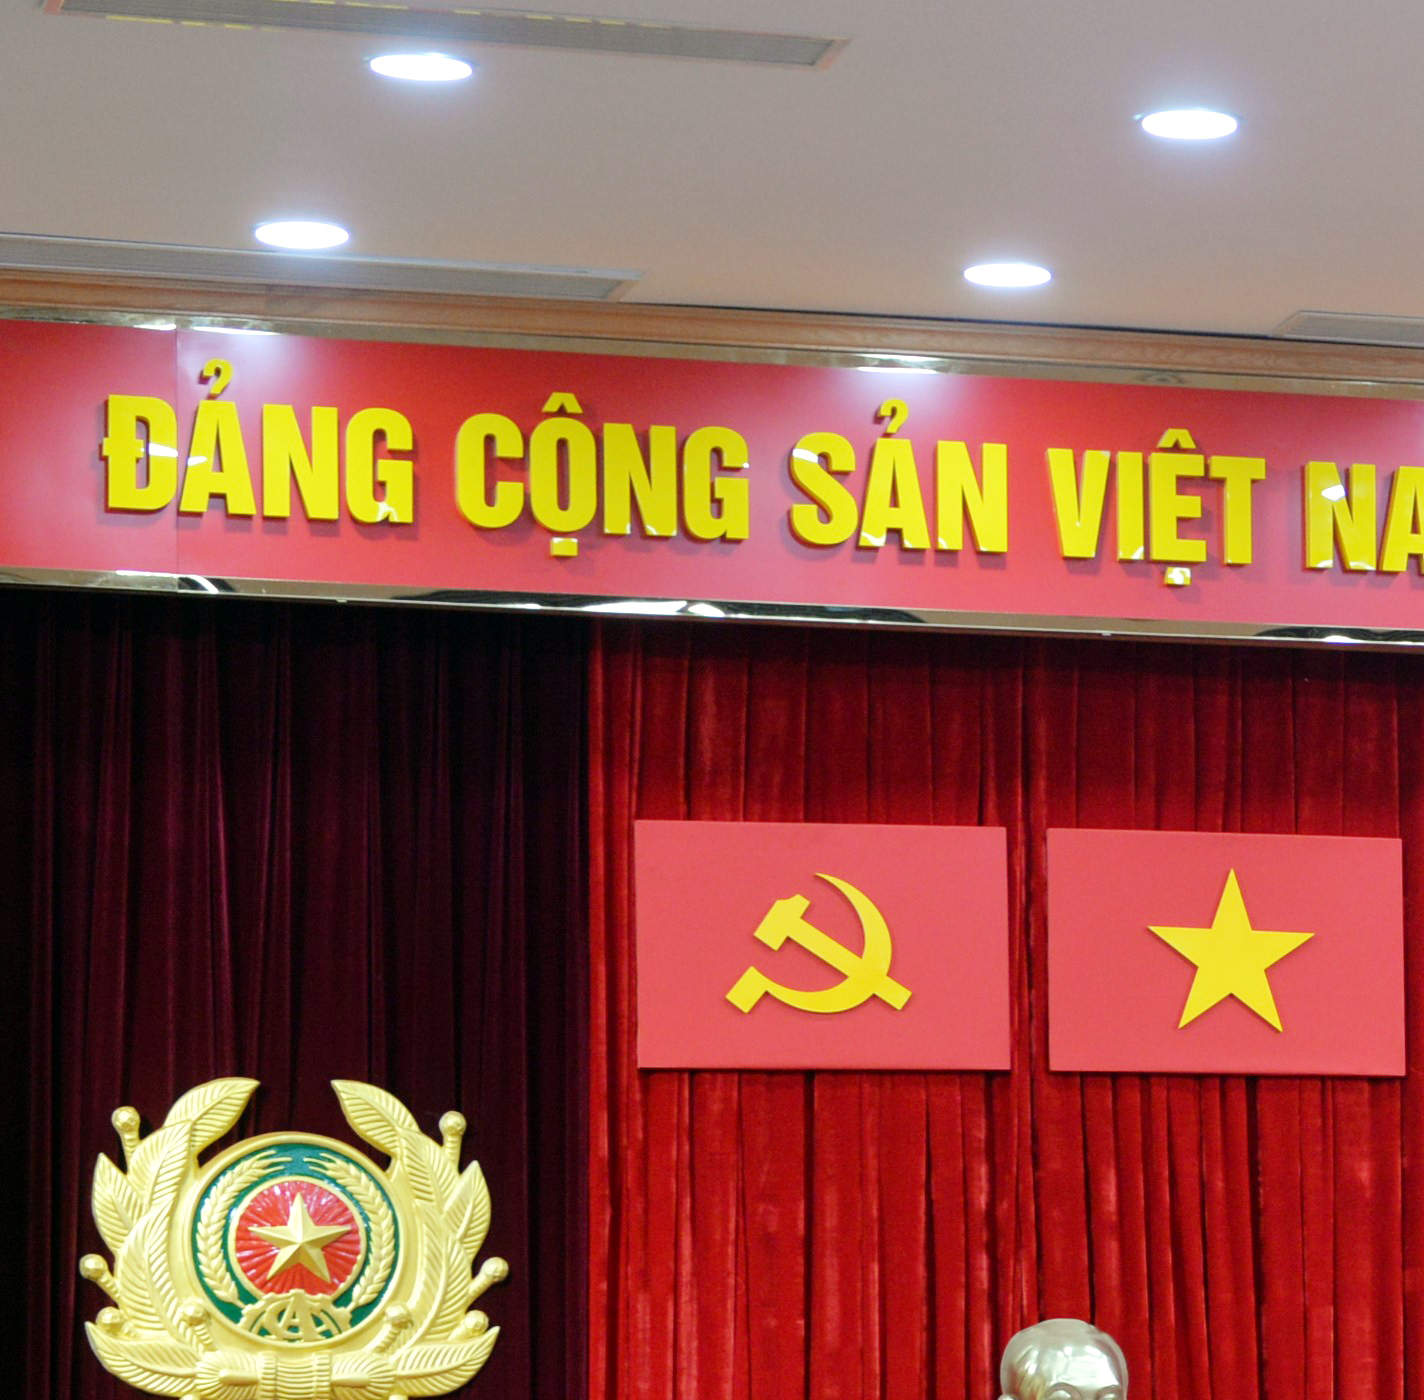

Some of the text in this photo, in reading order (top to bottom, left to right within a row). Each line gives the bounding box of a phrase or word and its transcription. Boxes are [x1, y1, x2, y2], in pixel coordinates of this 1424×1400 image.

[102, 360, 413, 523] ĐẢNG
[456, 393, 750, 556] CỘNG
[791, 400, 1008, 552] SẢN
[1047, 429, 1266, 585] VIỆT
